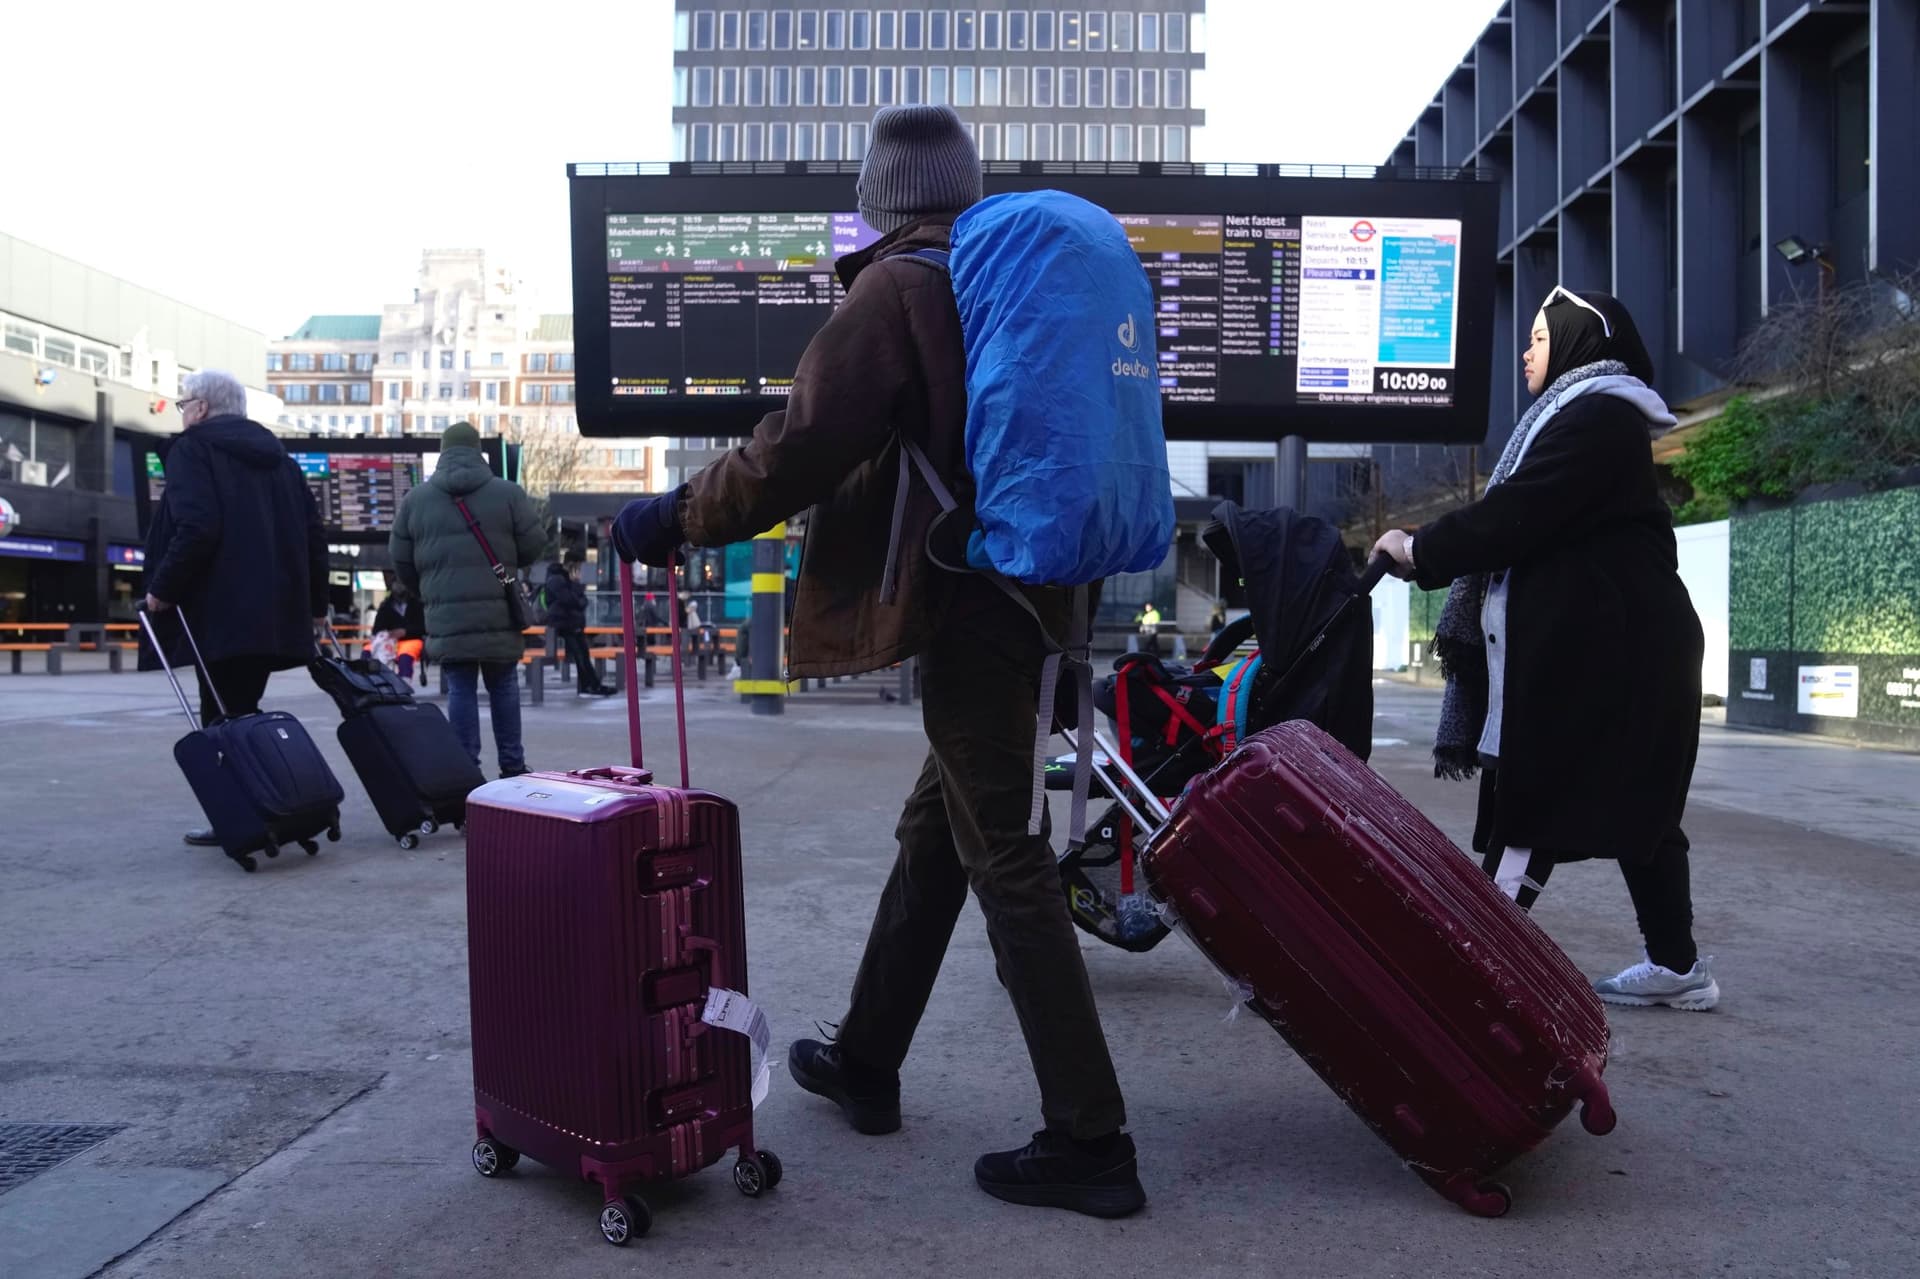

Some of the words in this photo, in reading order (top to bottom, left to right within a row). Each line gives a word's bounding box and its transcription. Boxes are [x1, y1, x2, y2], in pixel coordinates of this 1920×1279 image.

[609, 216, 627, 224] 10:15
[644, 216, 676, 225] Boarding
[719, 216, 752, 224] Boarding
[794, 216, 828, 224] Boarding
[1226, 215, 1250, 226] Next
[1252, 215, 1286, 226] fastest
[609, 228, 657, 236] Manchester
[834, 227, 858, 237] Tring
[1226, 228, 1249, 237] train
[1251, 228, 1262, 238] to
[684, 248, 690, 257] 2
[760, 247, 772, 256] 14
[834, 244, 856, 252] Wait
[1340, 245, 1374, 253] Junction
[610, 248, 622, 258] 13
[1380, 372, 1429, 390] 10:09
[1430, 377, 1446, 390] 00
[1344, 395, 1366, 404] major
[1366, 395, 1410, 404] engineering
[1411, 394, 1432, 403] works
